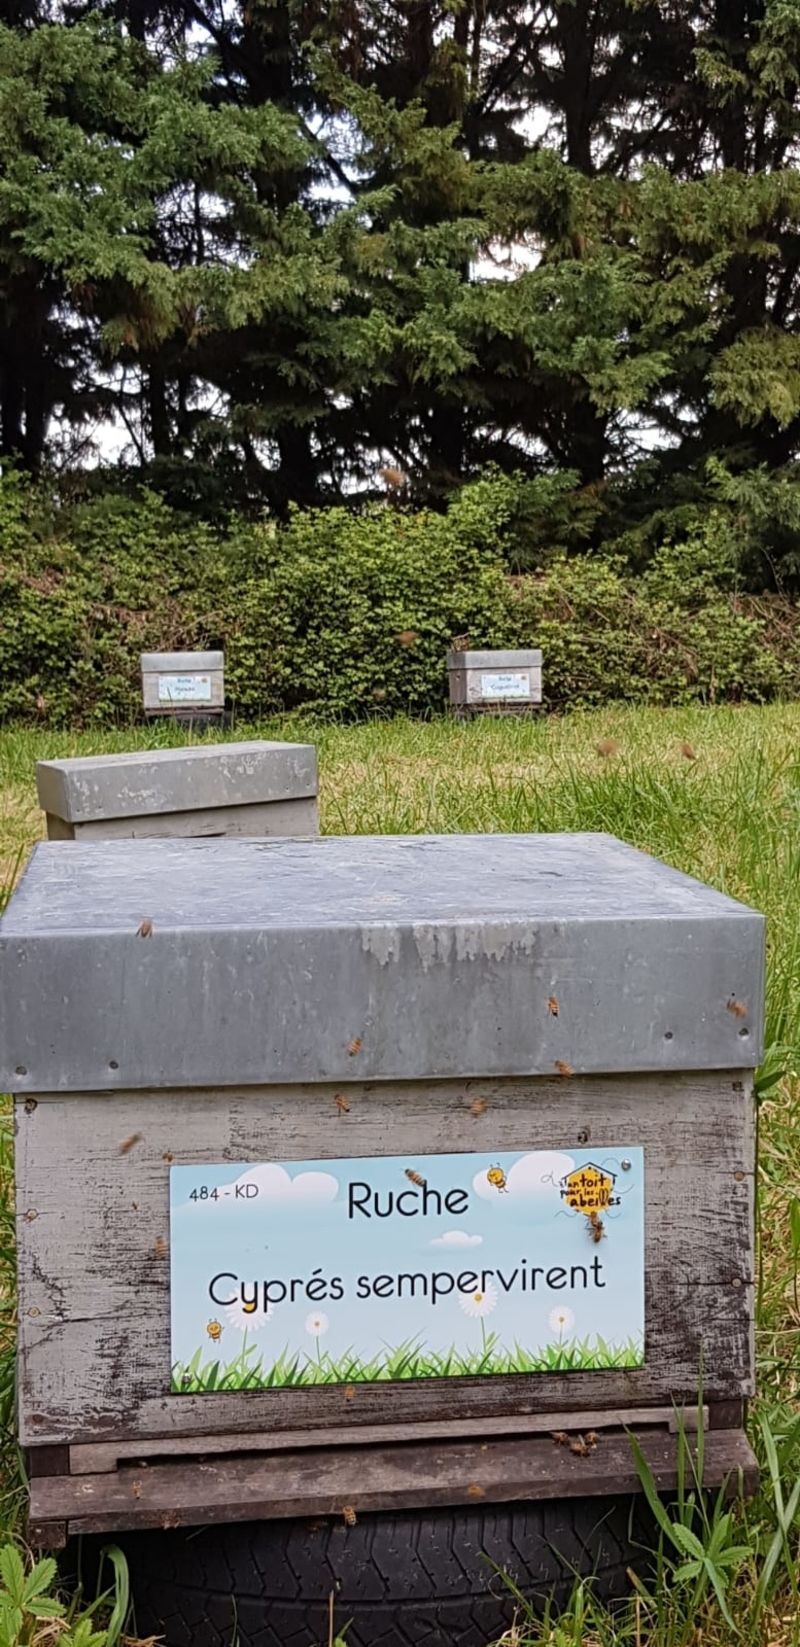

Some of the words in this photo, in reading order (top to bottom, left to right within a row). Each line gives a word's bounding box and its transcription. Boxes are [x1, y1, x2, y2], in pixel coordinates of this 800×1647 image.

[579, 1173, 608, 1188] toit
[189, 1185, 220, 1202] 484
[235, 1184, 259, 1199] KD
[347, 1180, 469, 1219] Ruche
[569, 1188, 621, 1207] abeilles
[208, 1268, 344, 1314] Cyprés
[356, 1255, 606, 1305] sempervirent
